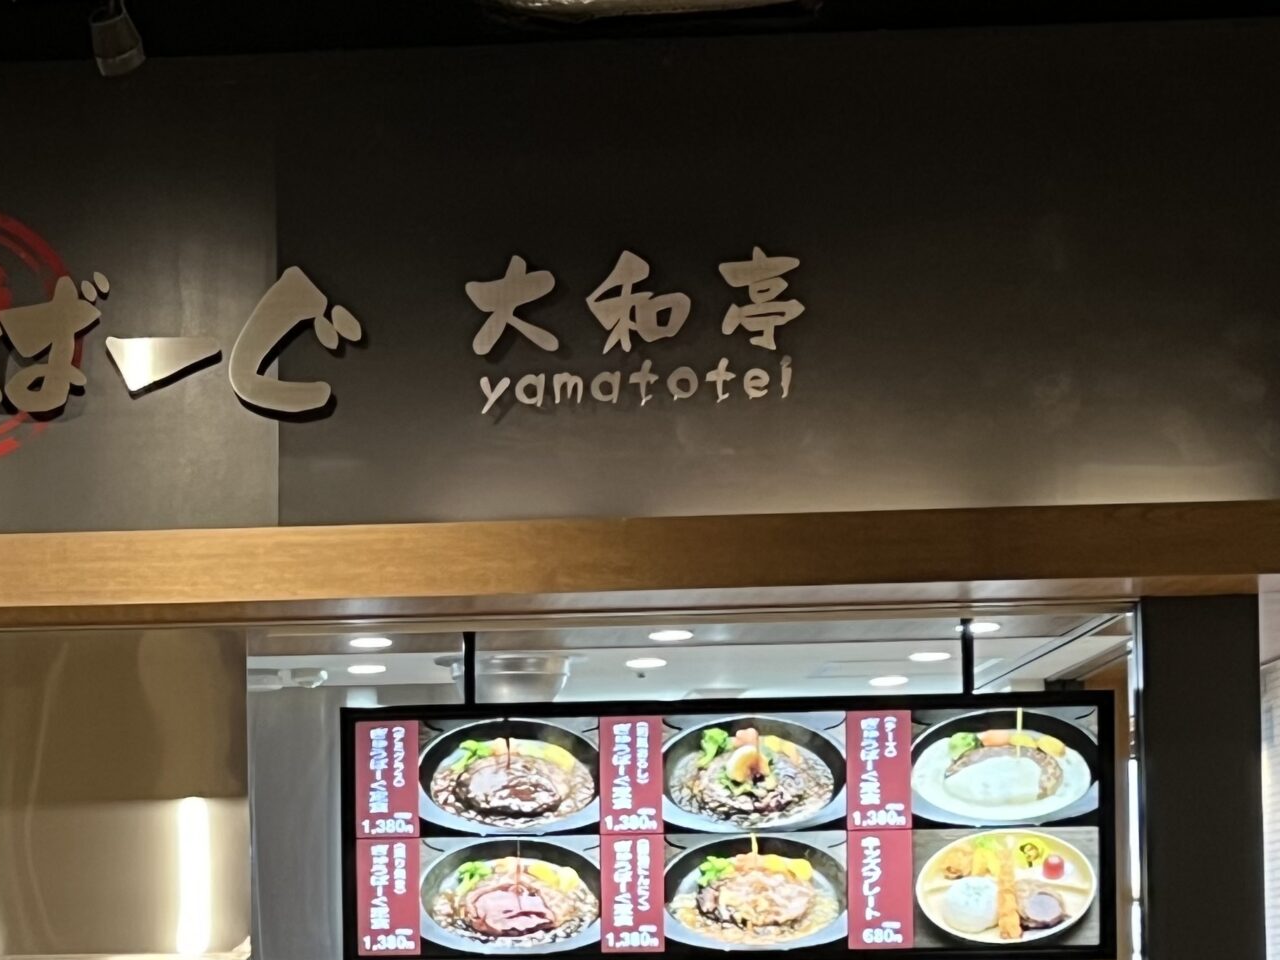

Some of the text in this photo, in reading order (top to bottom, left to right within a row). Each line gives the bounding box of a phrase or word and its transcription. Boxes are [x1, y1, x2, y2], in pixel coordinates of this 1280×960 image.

[465, 247, 805, 354] 大和亭
[480, 356, 794, 414] yamatotei
